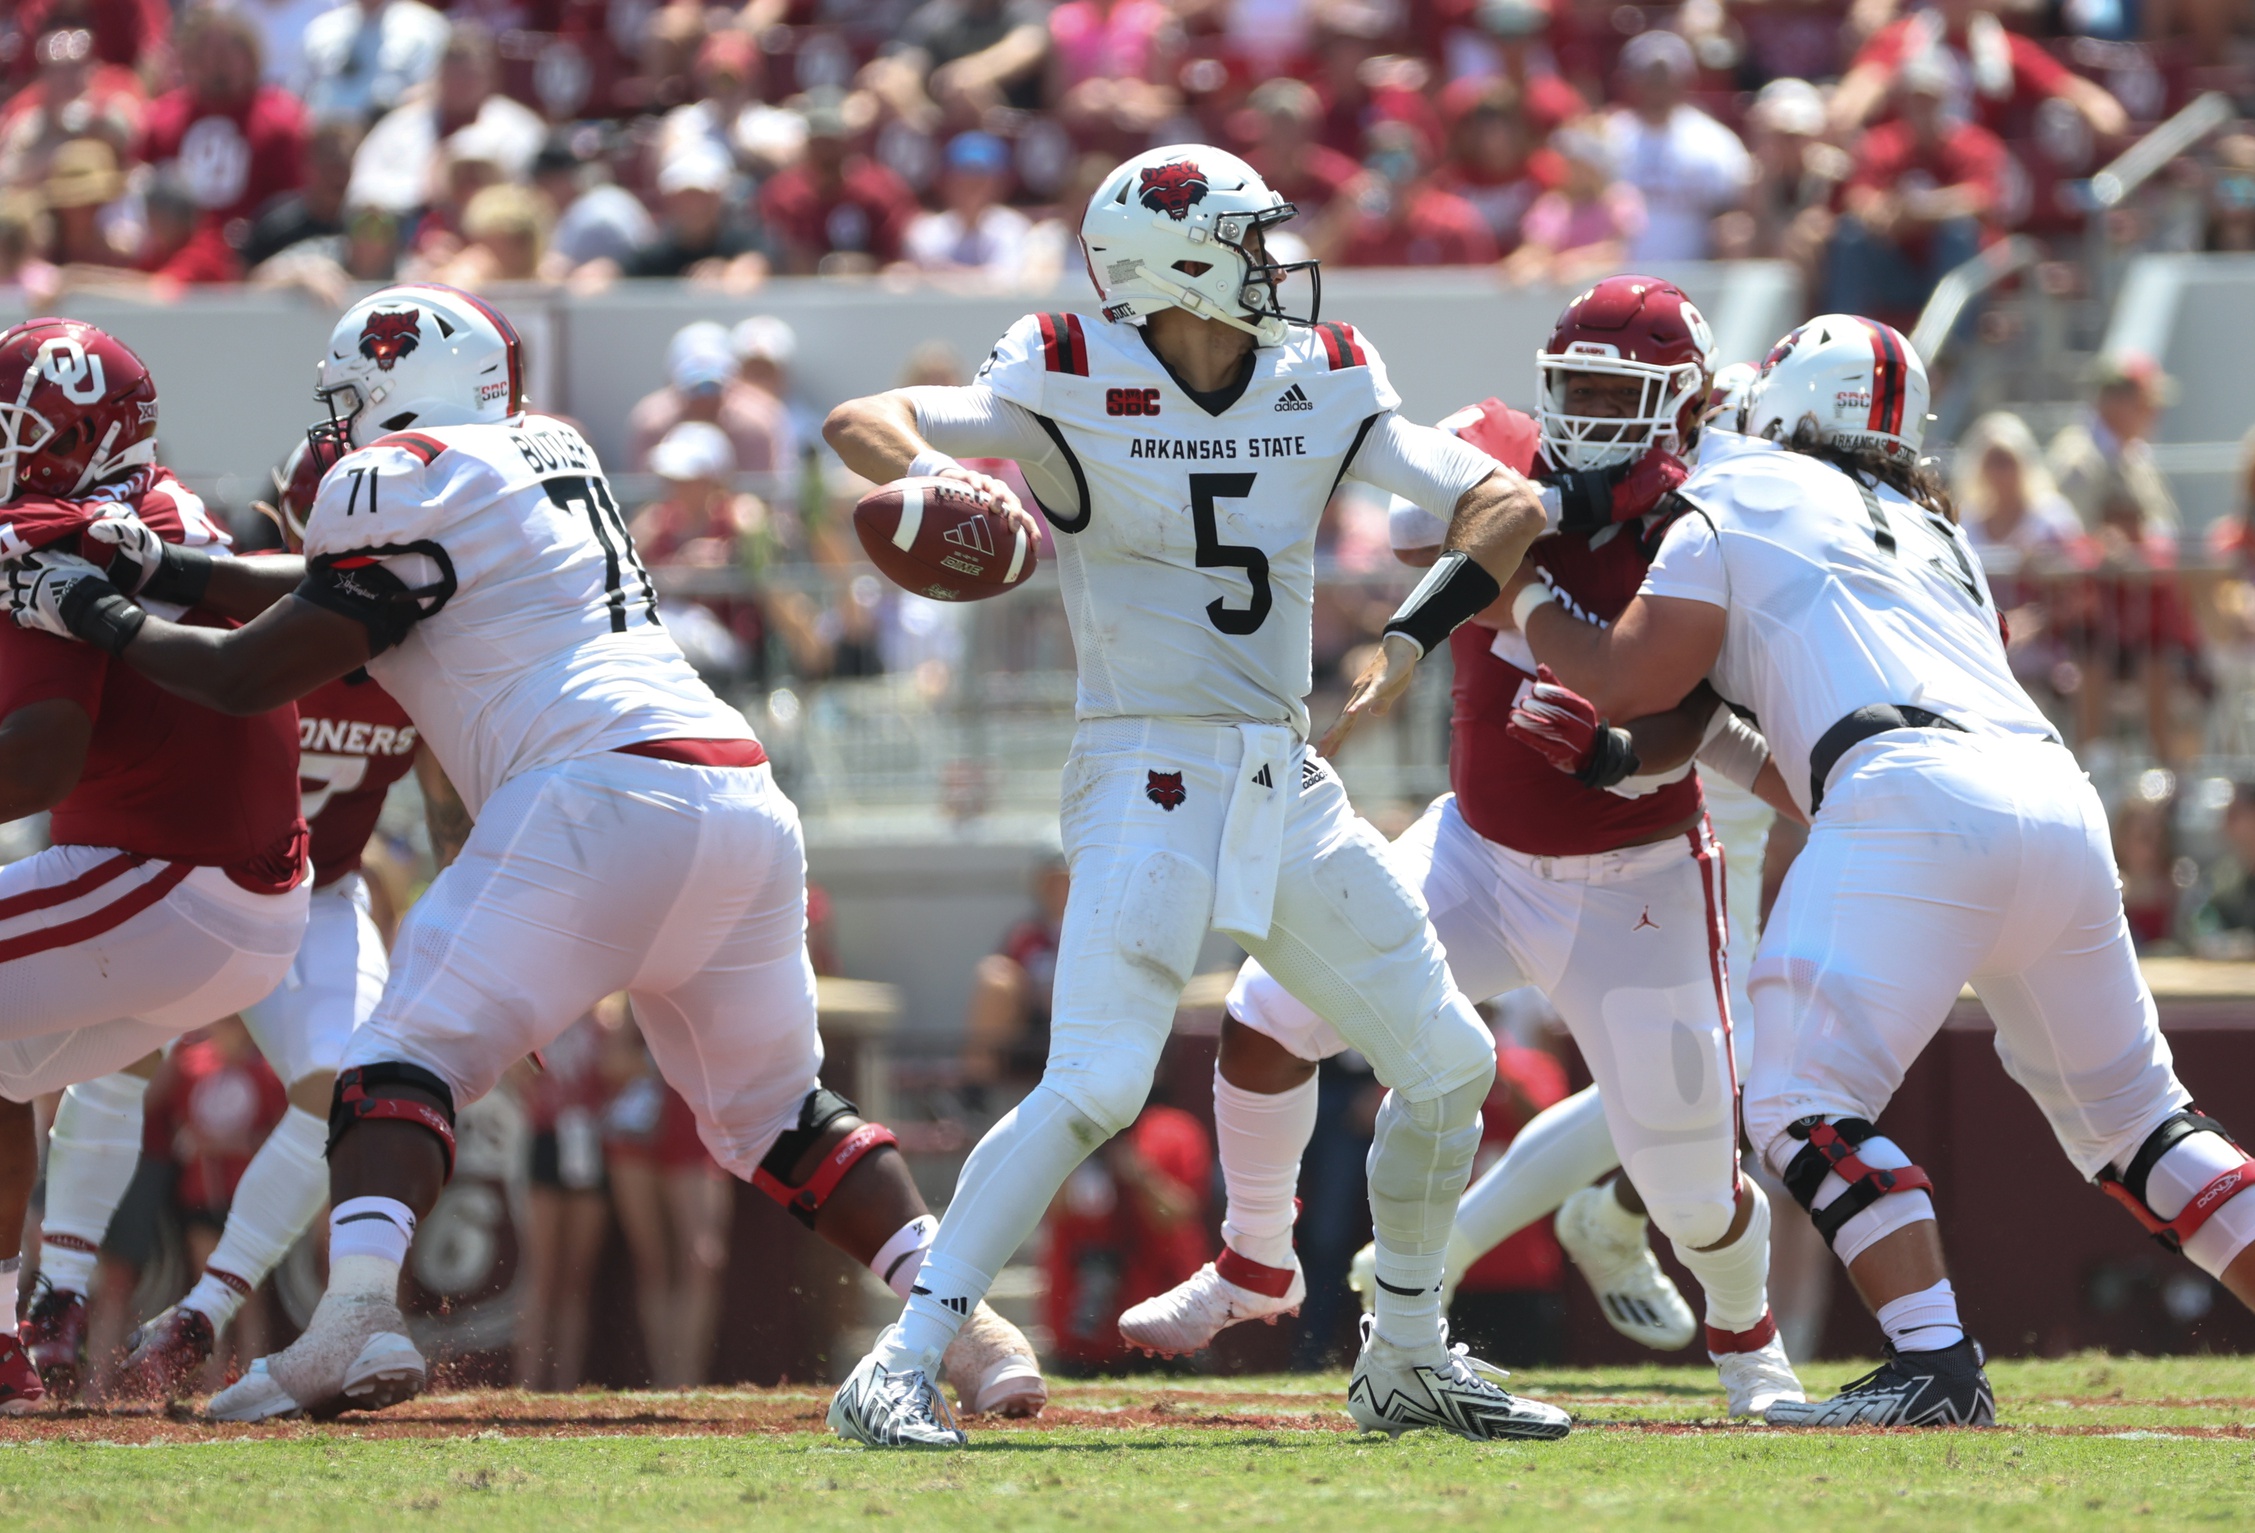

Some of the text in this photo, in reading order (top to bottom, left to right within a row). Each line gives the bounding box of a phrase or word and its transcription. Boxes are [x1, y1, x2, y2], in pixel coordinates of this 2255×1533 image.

[38, 337, 107, 405] OU
[481, 381, 508, 401] SBC
[1106, 388, 1162, 417] SBC
[1836, 391, 1871, 408] SBC
[1274, 400, 1313, 412] adidas
[1130, 436, 1307, 459] ARKANSAS STATE
[347, 466, 379, 516] 71
[541, 474, 663, 634] 71
[1188, 472, 1273, 635] 5
